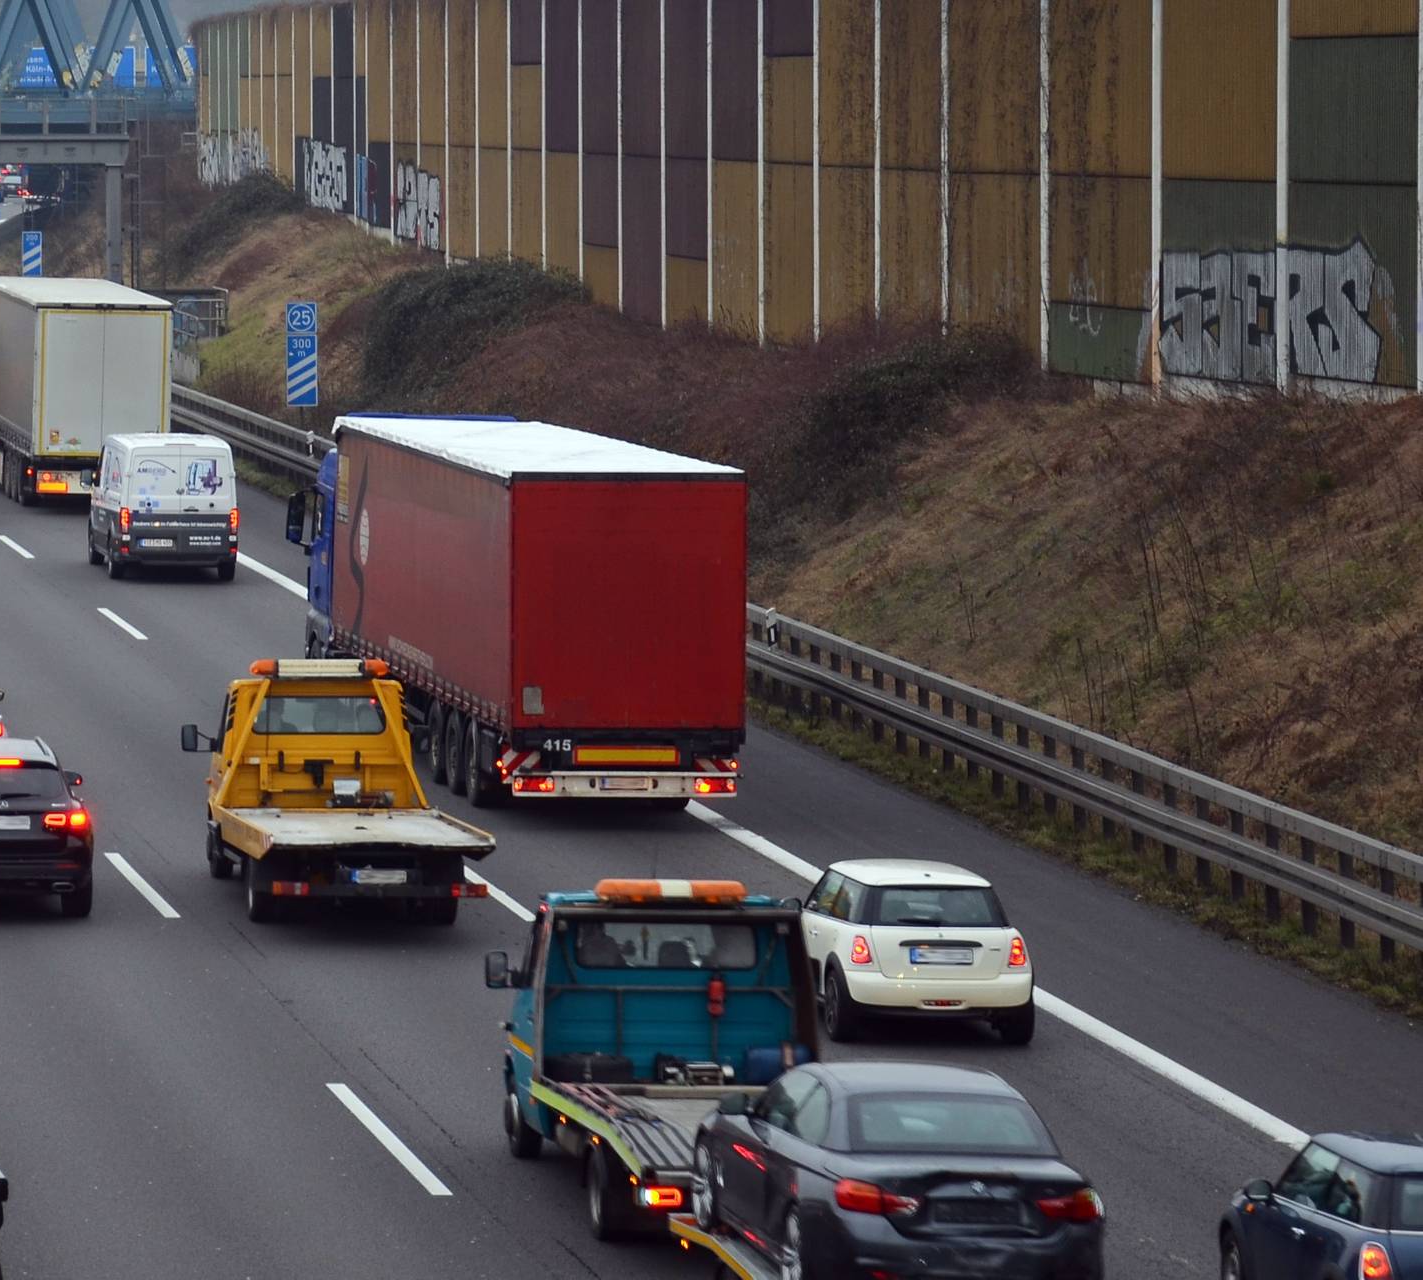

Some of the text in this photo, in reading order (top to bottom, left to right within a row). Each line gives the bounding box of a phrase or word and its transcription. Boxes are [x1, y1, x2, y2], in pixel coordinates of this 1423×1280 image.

[291, 310, 311, 326] 25
[292, 338, 311, 349] 300
[543, 739, 572, 752] 415
